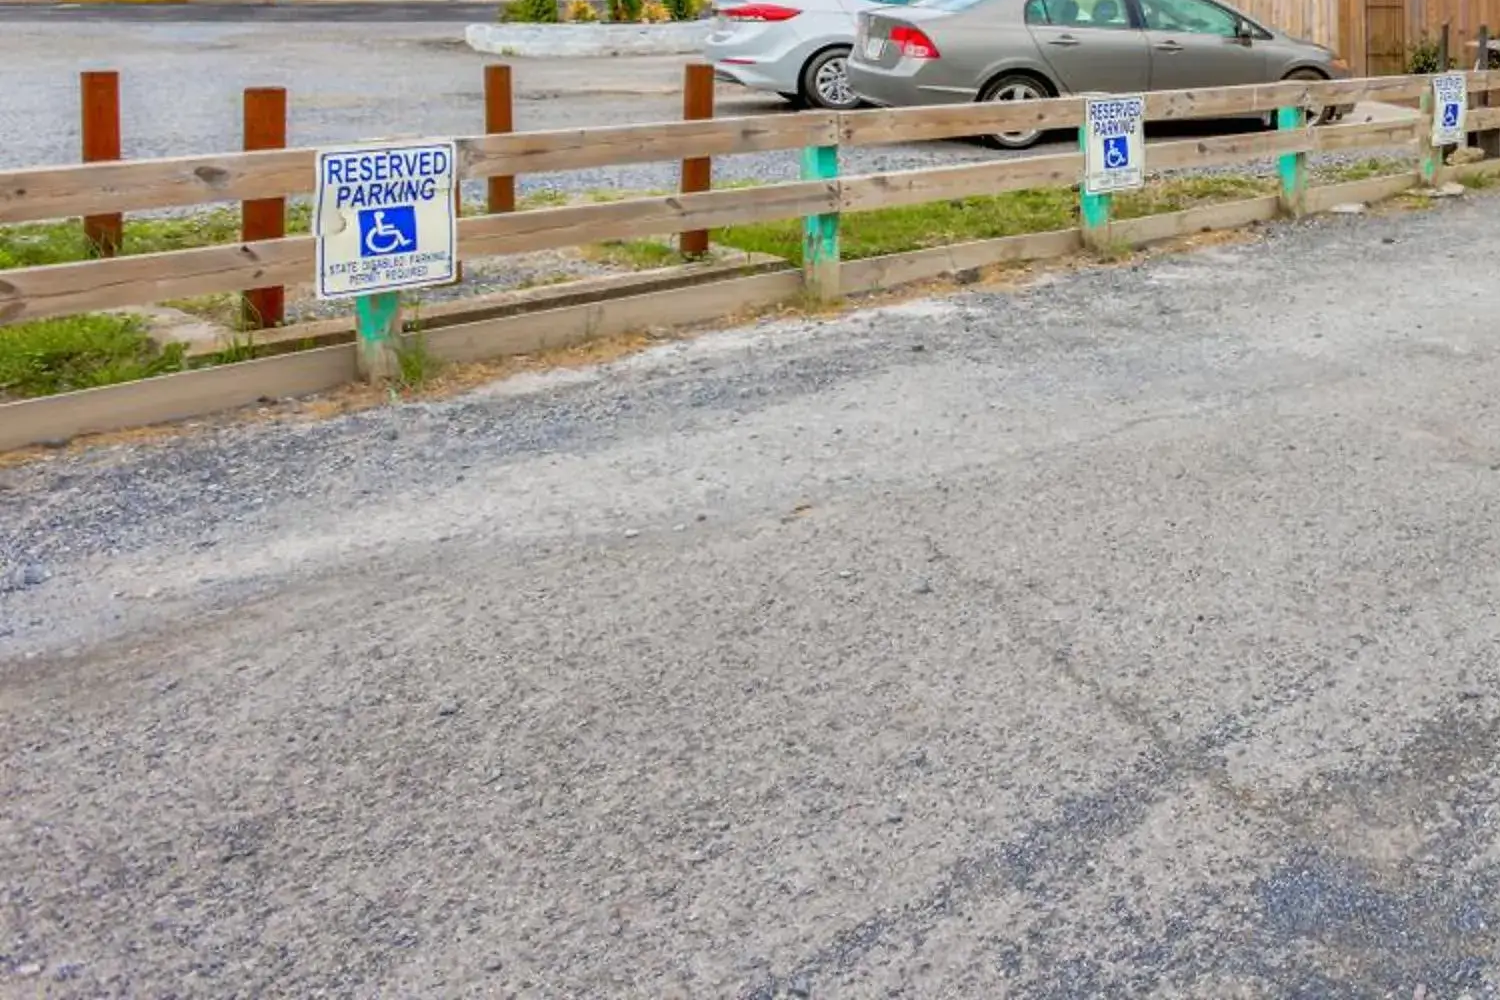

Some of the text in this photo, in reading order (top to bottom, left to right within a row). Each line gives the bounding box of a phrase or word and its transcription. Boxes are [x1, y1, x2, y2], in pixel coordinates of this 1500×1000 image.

[1090, 101, 1140, 120] RESERVED
[1095, 118, 1134, 135] PARKING
[327, 151, 447, 185] RESERVED
[336, 177, 435, 209] PARKING
[329, 260, 357, 275] STATE
